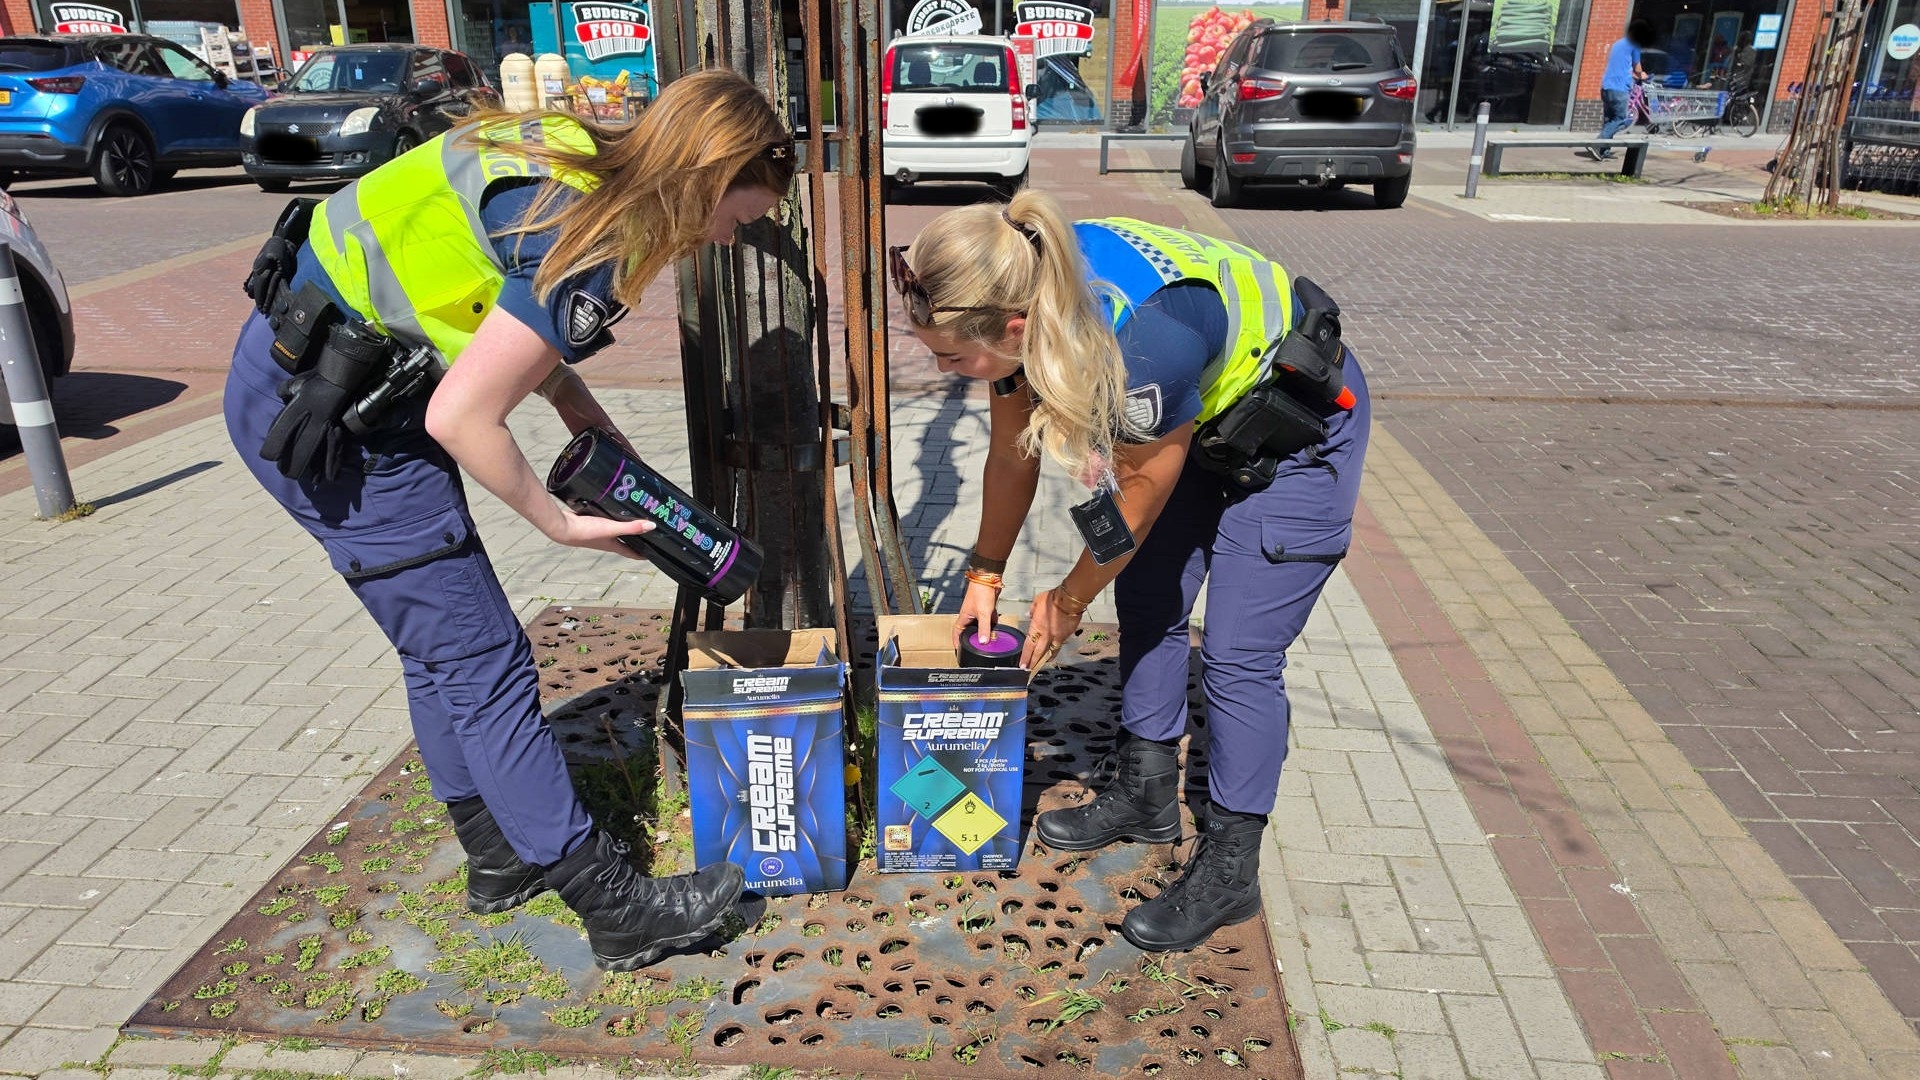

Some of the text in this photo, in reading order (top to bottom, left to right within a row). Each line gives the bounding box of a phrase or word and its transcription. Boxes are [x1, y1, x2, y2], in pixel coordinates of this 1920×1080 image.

[58, 8, 115, 23] BUDGET
[581, 7, 639, 22] BUDGET
[914, 0, 963, 30] BUDGET FOOD
[1025, 7, 1085, 21] BUDGET
[68, 24, 112, 34] FOOD
[589, 23, 635, 39] FOOD
[1031, 22, 1078, 39] FOOD
[666, 496, 692, 520] MAX
[630, 489, 713, 551] GREATWHIP
[924, 741, 985, 751] Aurumella
[961, 834, 980, 842] 5.1
[744, 877, 803, 889] Aurumella
